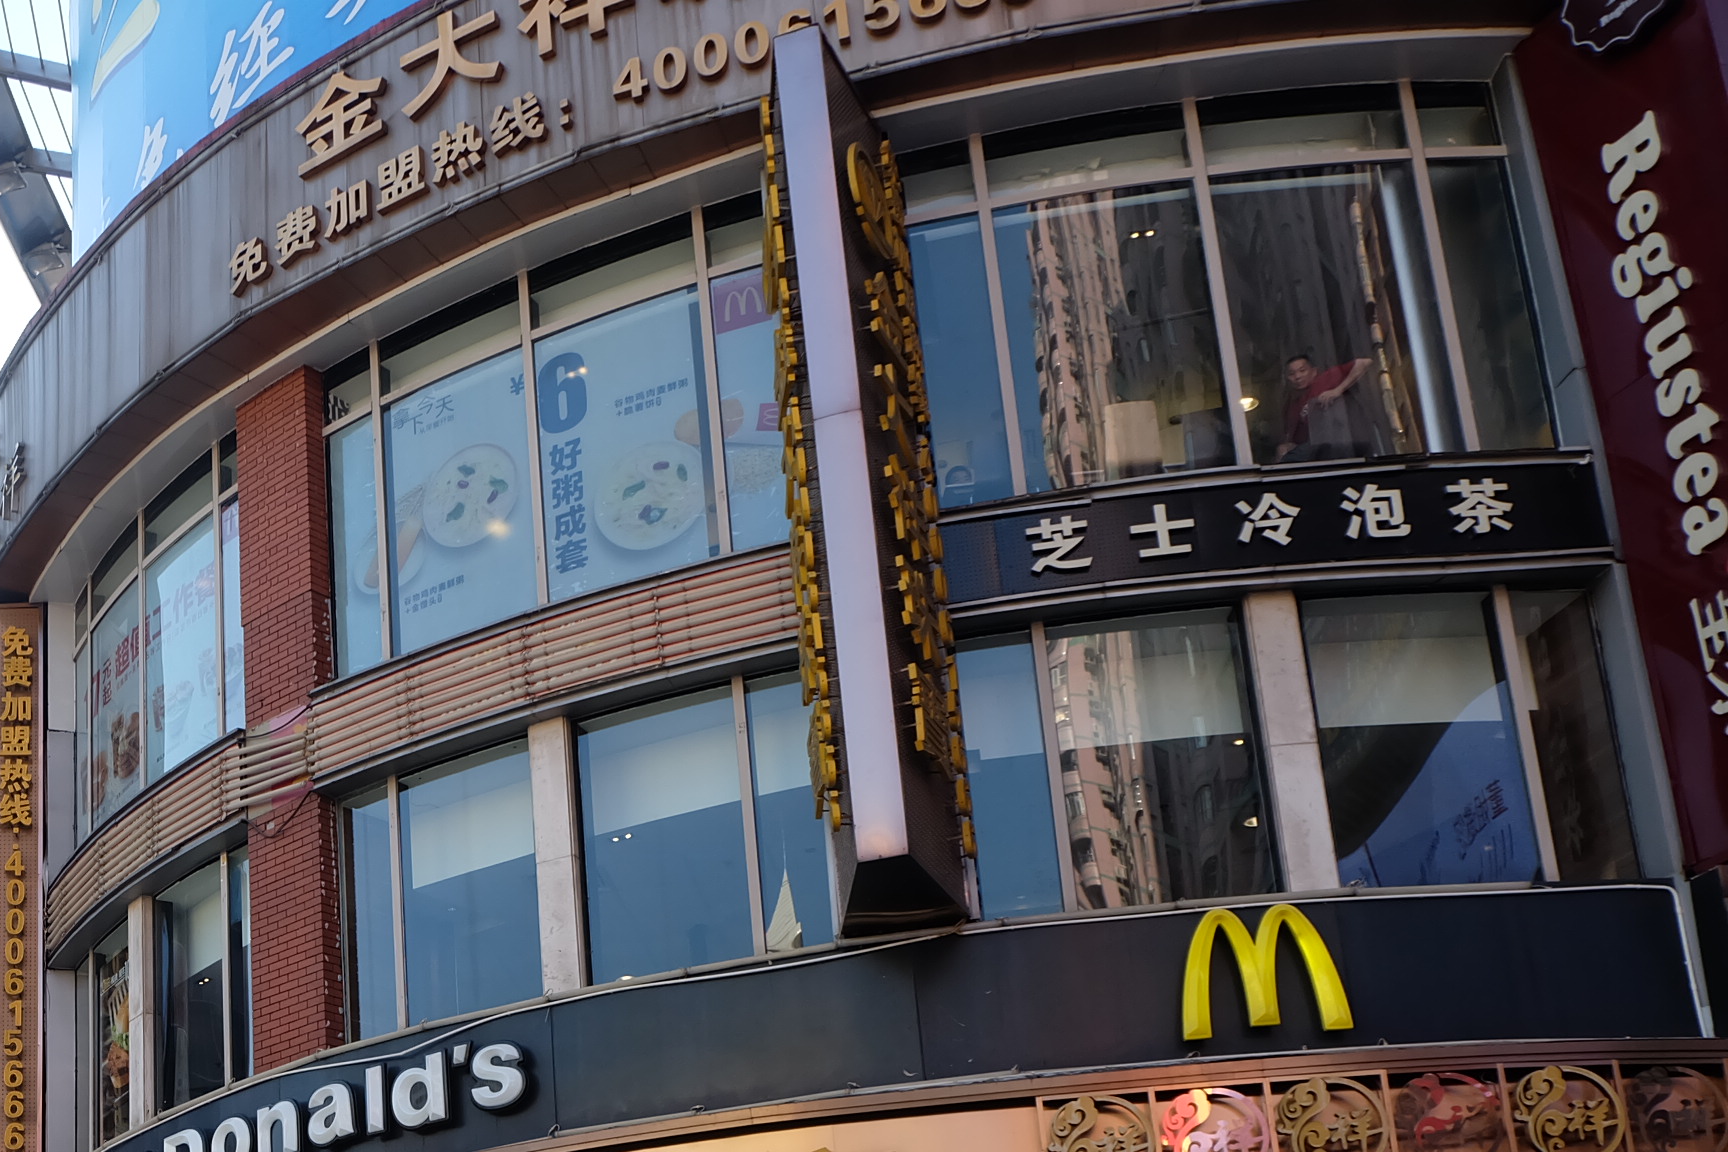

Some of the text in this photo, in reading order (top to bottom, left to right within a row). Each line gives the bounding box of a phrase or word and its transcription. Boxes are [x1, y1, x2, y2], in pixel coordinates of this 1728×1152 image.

[549, 437, 589, 575] 好粥成套
[1025, 478, 1515, 574] 芝士冷泡茶
